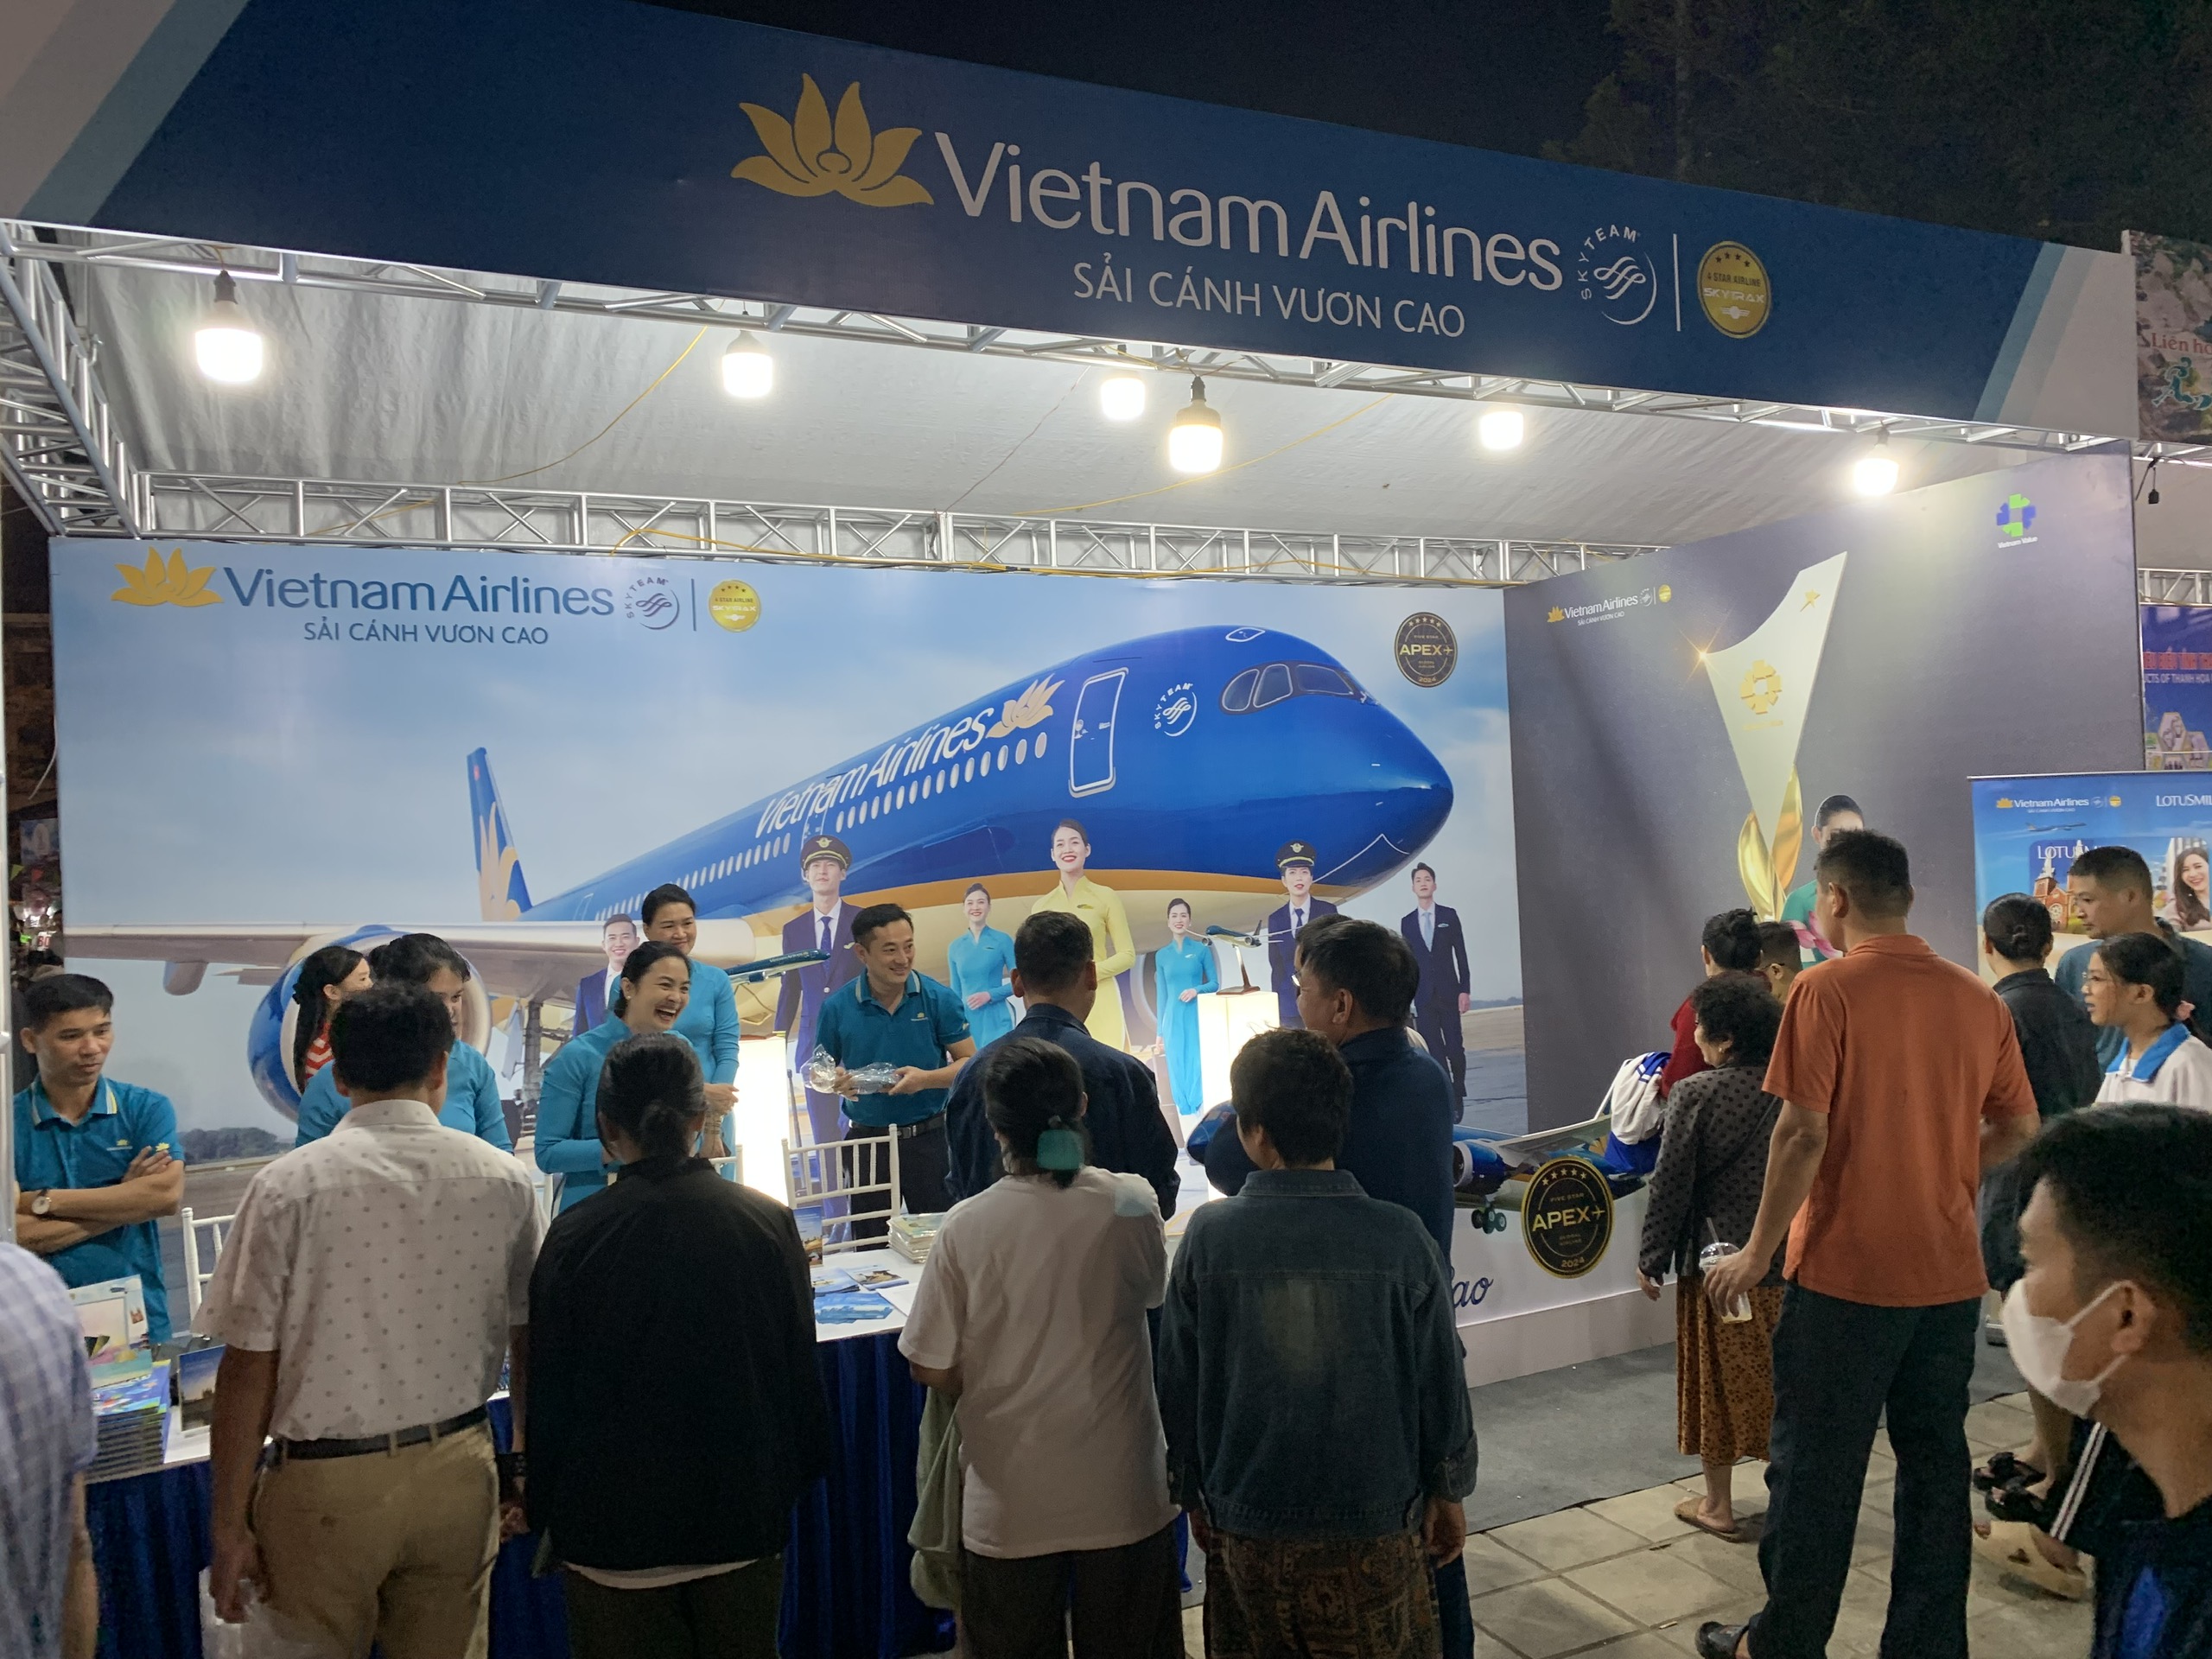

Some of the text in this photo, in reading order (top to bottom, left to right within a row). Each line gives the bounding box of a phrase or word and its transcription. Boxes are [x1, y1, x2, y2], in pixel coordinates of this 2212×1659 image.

[934, 131, 1563, 291] Vietnam Airlines
[1577, 224, 1637, 300] SKYTEAM
[1713, 271, 1732, 283] STAR
[1732, 274, 1762, 287] AIRLINE
[1073, 251, 1465, 338] SẢI CÁNH VƯƠN CAO
[1703, 287, 1765, 303] SKYTRAX
[2151, 332, 2190, 353] Liên
[223, 566, 615, 616] Vietnam Airlines
[624, 576, 666, 620] SKYTEAM
[1564, 602, 1603, 620] Vietnam
[1602, 594, 1639, 611] Airlines
[303, 616, 549, 645] SẢI CÁNH VƯƠN CAO
[755, 707, 995, 839] Vietnam Airlines
[2014, 799, 2054, 808] Vietnam
[2054, 798, 2089, 807] Airlines
[1560, 1256, 1586, 1268] 2024
[1451, 1266, 1495, 1308] ao
